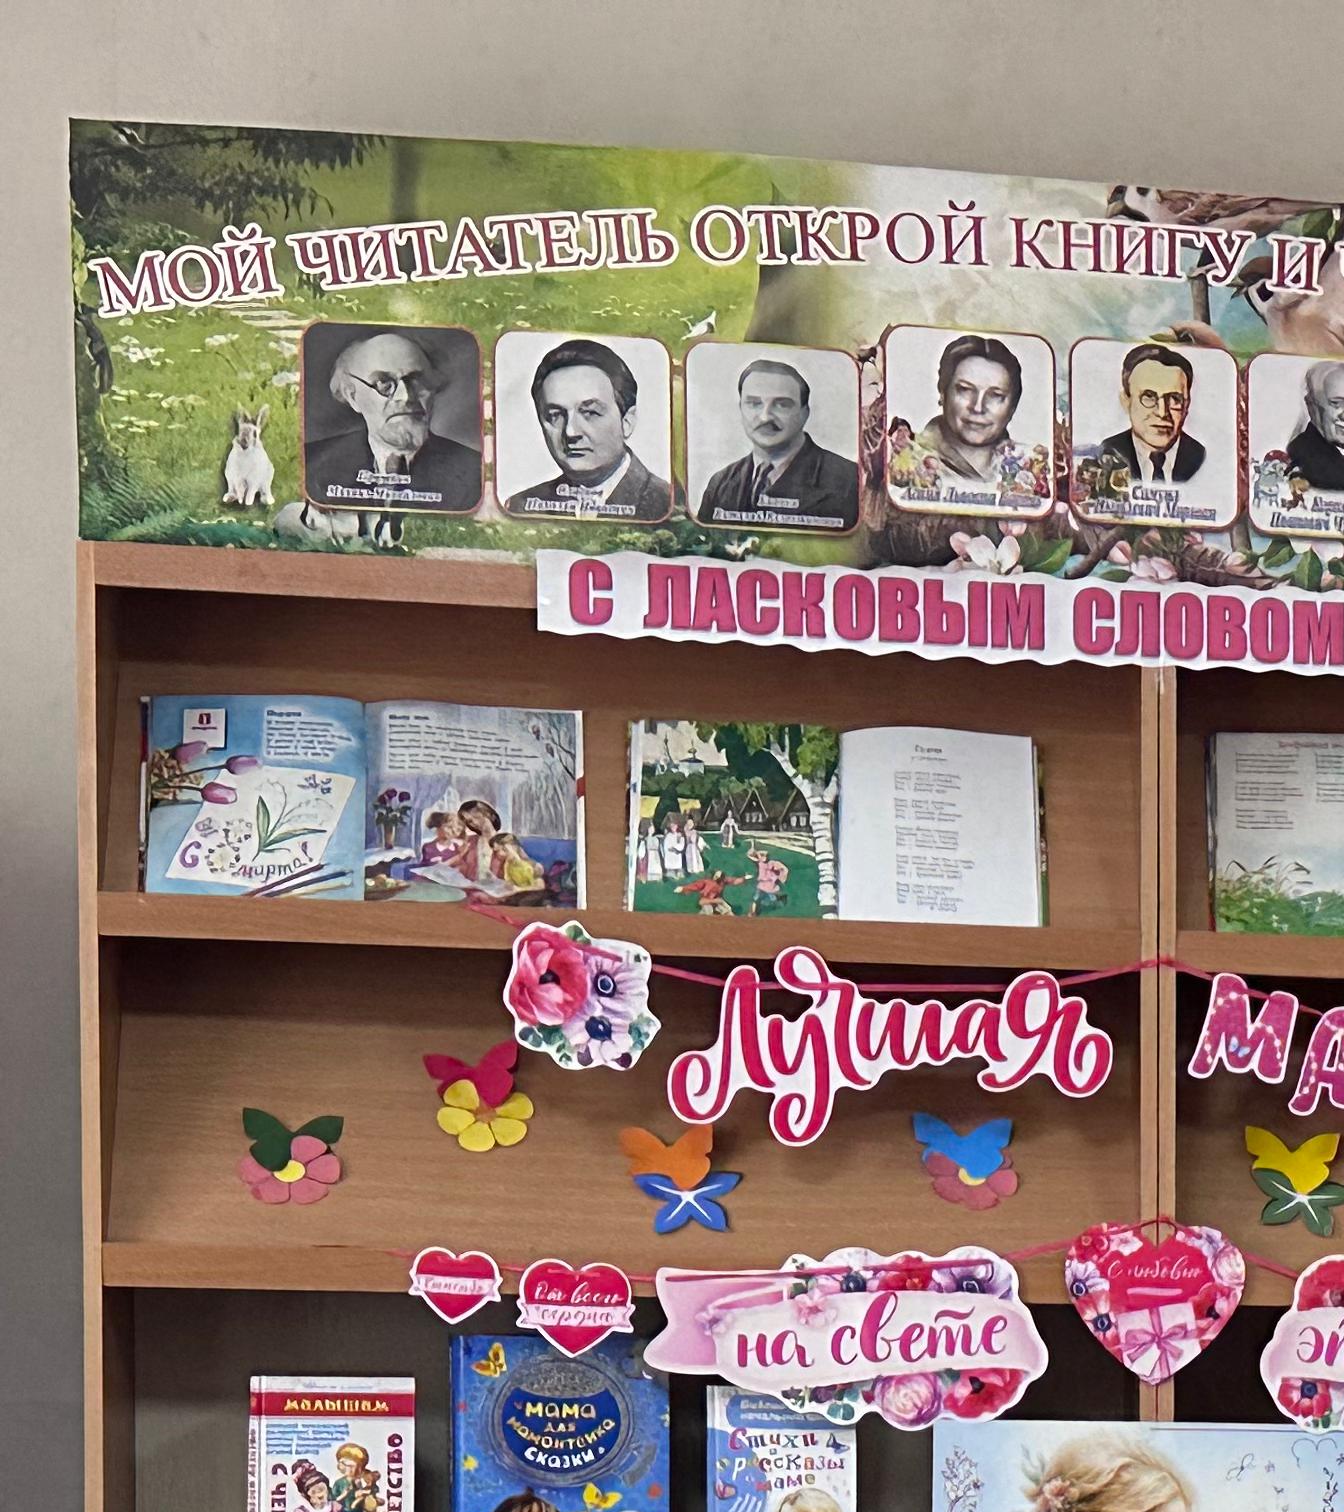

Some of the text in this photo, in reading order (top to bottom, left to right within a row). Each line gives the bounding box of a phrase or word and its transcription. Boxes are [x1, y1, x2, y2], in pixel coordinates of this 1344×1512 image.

[92, 224, 282, 316] МОЙ
[291, 209, 676, 289] ЧИТАТЕЛЬ
[691, 200, 990, 266] ОТКРОЙ
[1010, 215, 1252, 286] КНИГУ
[1270, 235, 1323, 294] И
[568, 557, 613, 627] С
[642, 563, 1045, 650] ЛАСКОВЫМ
[1073, 588, 1344, 667] СЛОВОМ
[670, 950, 1109, 1142] Лучшая
[735, 1295, 1008, 1369] на свете
